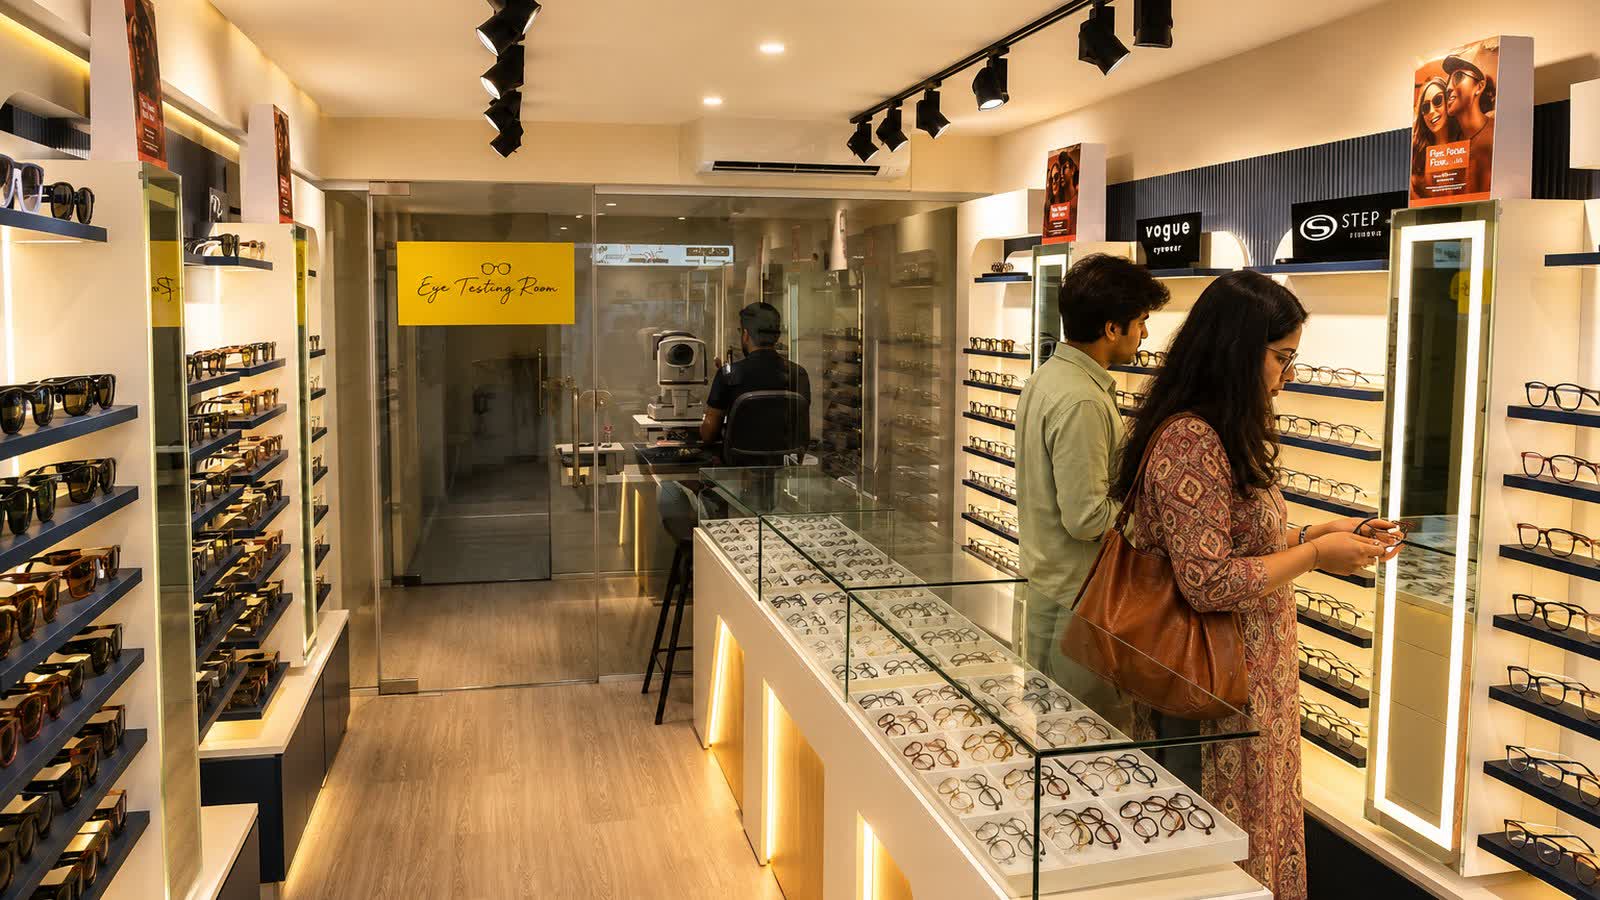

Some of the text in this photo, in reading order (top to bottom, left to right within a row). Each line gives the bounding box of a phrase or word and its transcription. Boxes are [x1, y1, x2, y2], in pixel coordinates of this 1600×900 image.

[1341, 210, 1380, 228] STEP
[1145, 221, 1190, 242] vogue
[417, 275, 558, 305] Eye Testing Room
